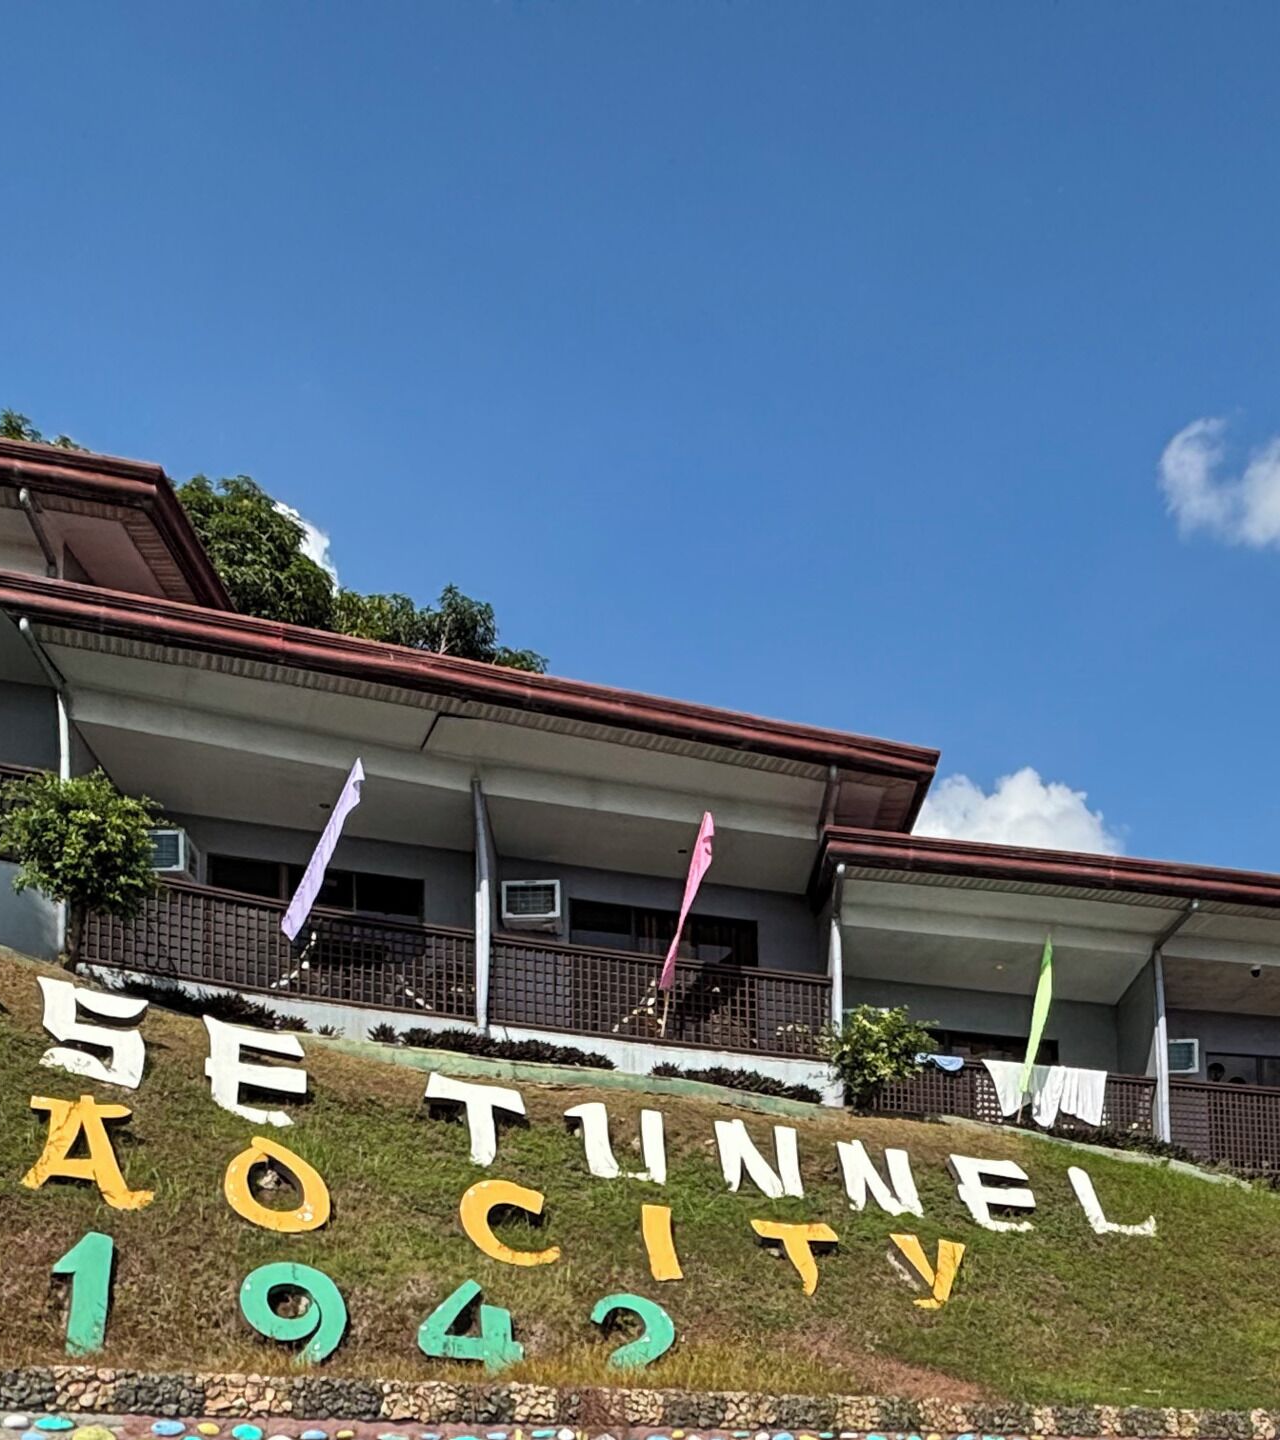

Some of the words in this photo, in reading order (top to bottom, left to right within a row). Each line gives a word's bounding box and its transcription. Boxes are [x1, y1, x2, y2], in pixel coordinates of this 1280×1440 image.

[423, 1071, 1157, 1237] TUNNEL
[51, 1231, 675, 1374] 1942
[458, 1179, 966, 1310] CITY
